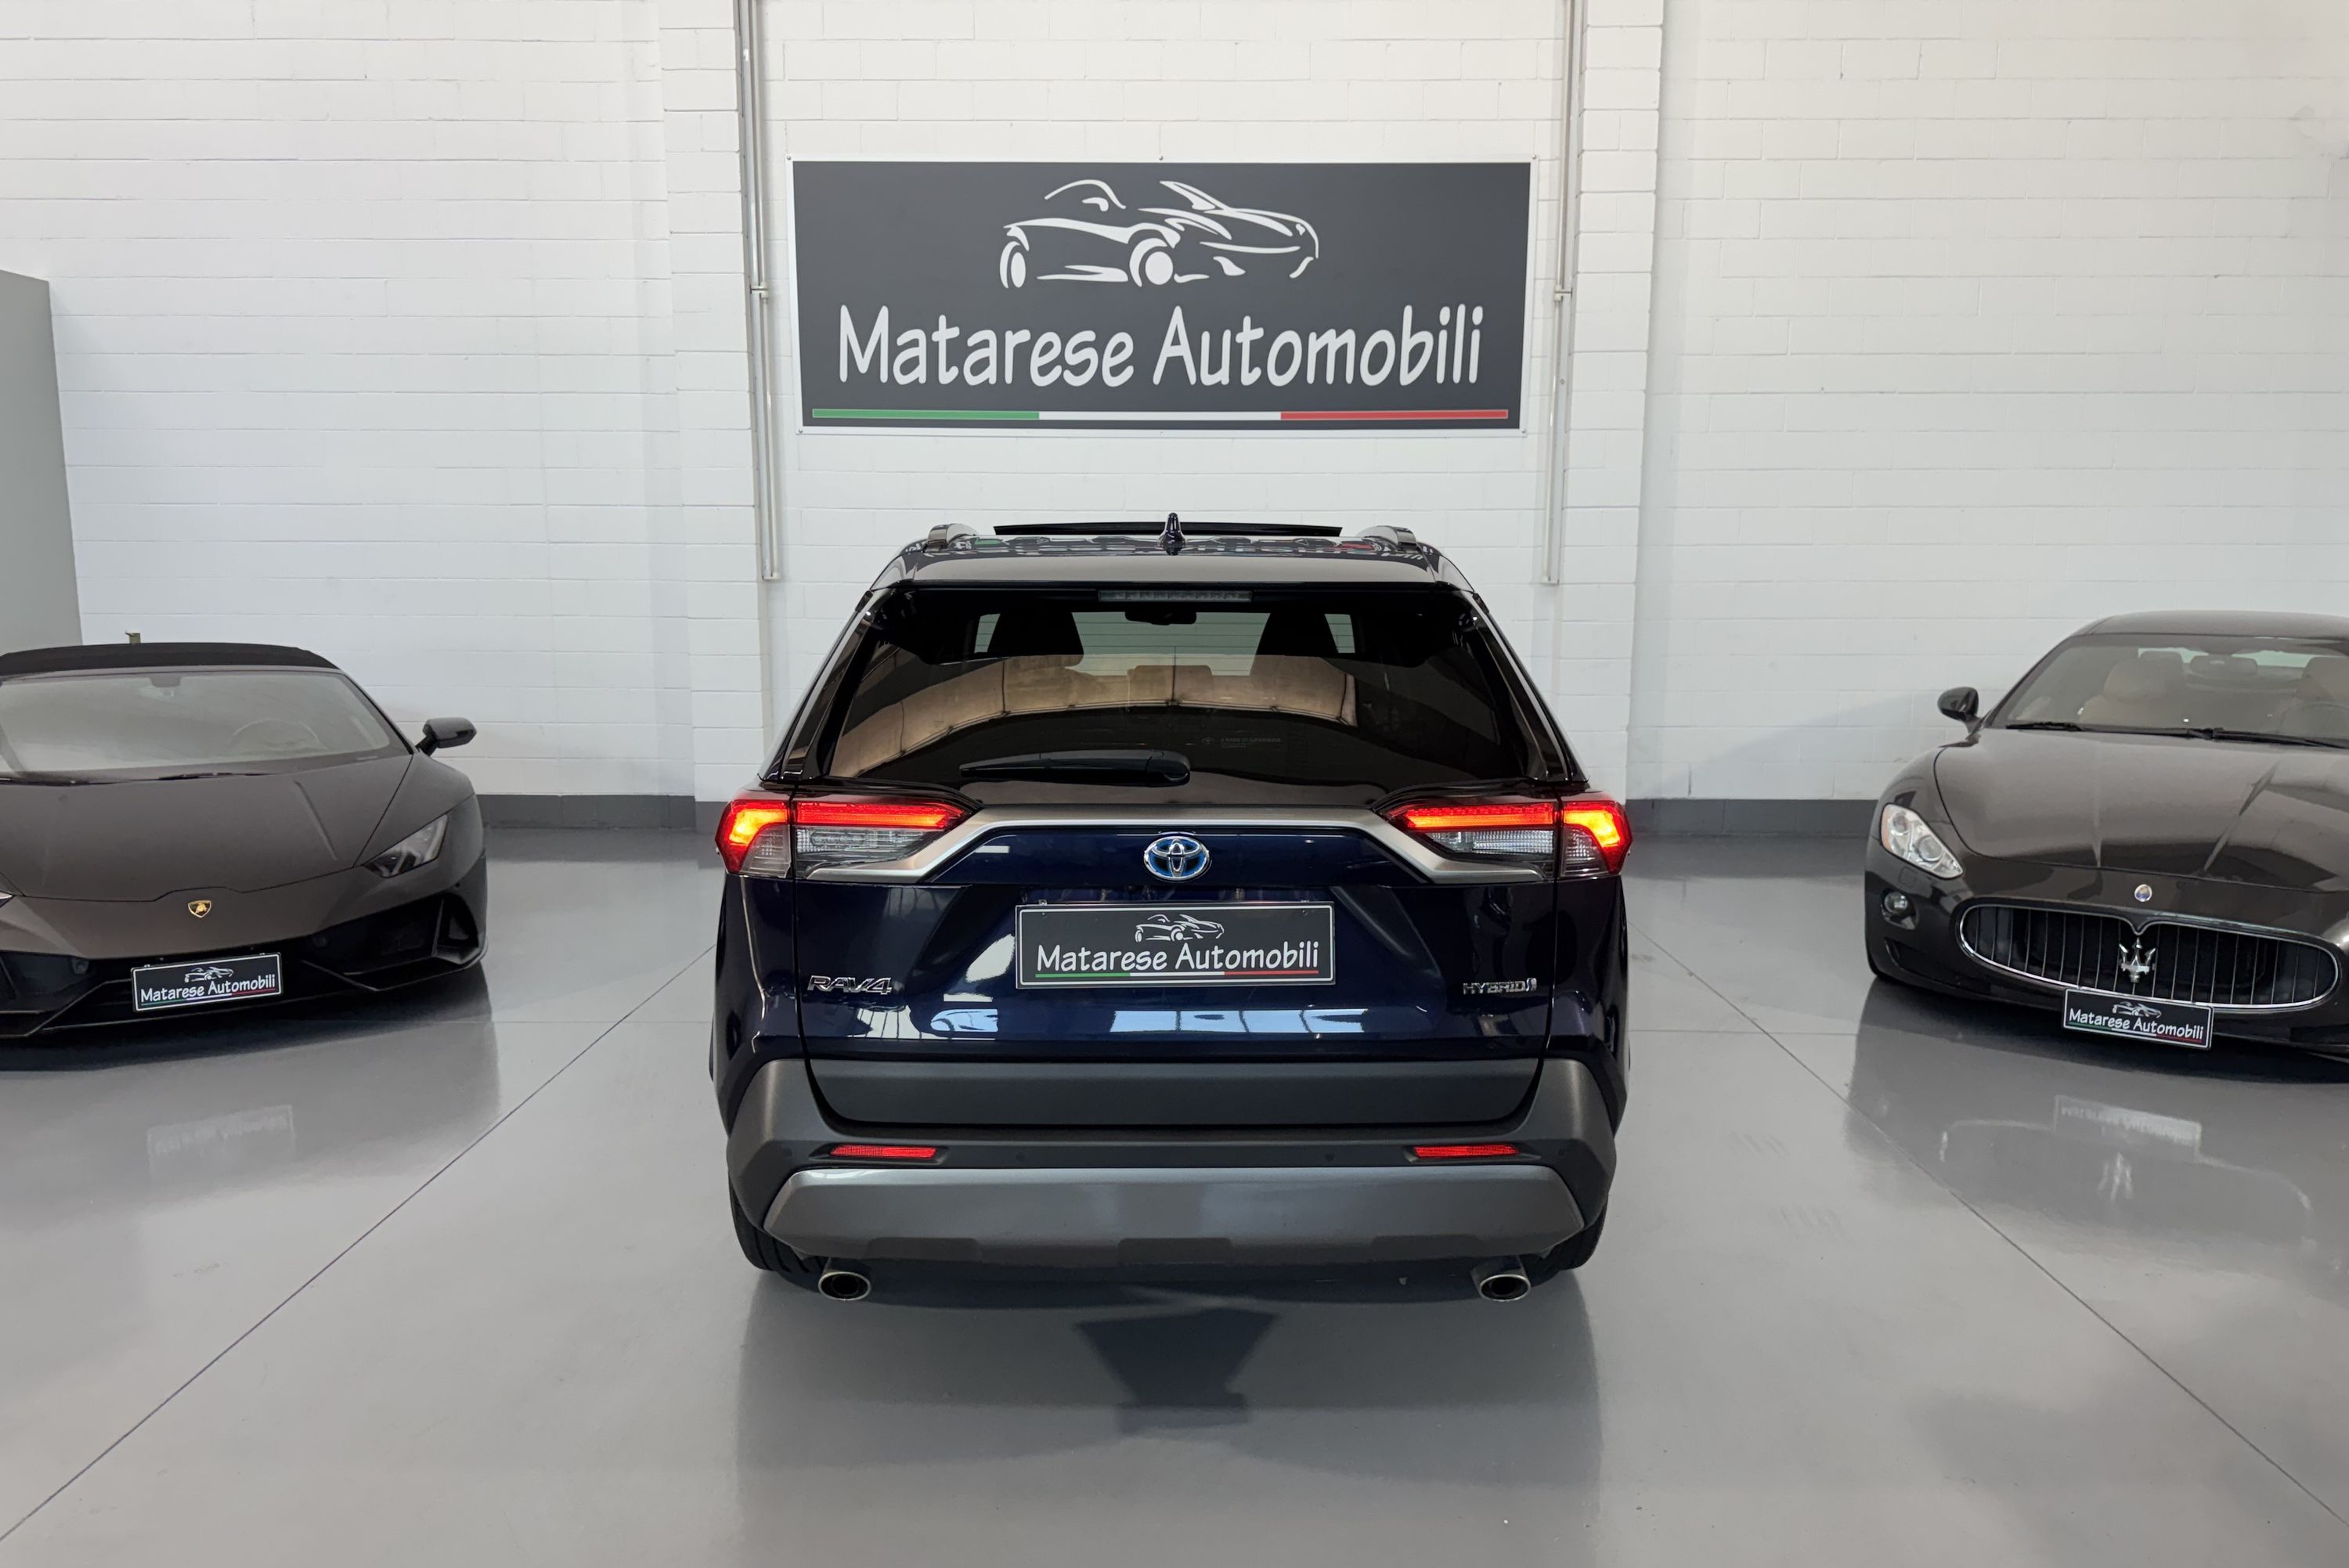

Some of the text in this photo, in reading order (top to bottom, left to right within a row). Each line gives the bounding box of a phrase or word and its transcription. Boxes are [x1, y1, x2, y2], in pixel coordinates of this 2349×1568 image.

[839, 304, 1484, 387] Matarese Automobili
[1037, 940, 1319, 972] Matarese Automobili
[140, 974, 276, 1004] Matarese Automobili
[807, 975, 892, 995] RAV4
[1463, 980, 1526, 995] HYBRID
[2069, 1007, 2204, 1040] Matarese Automobili
